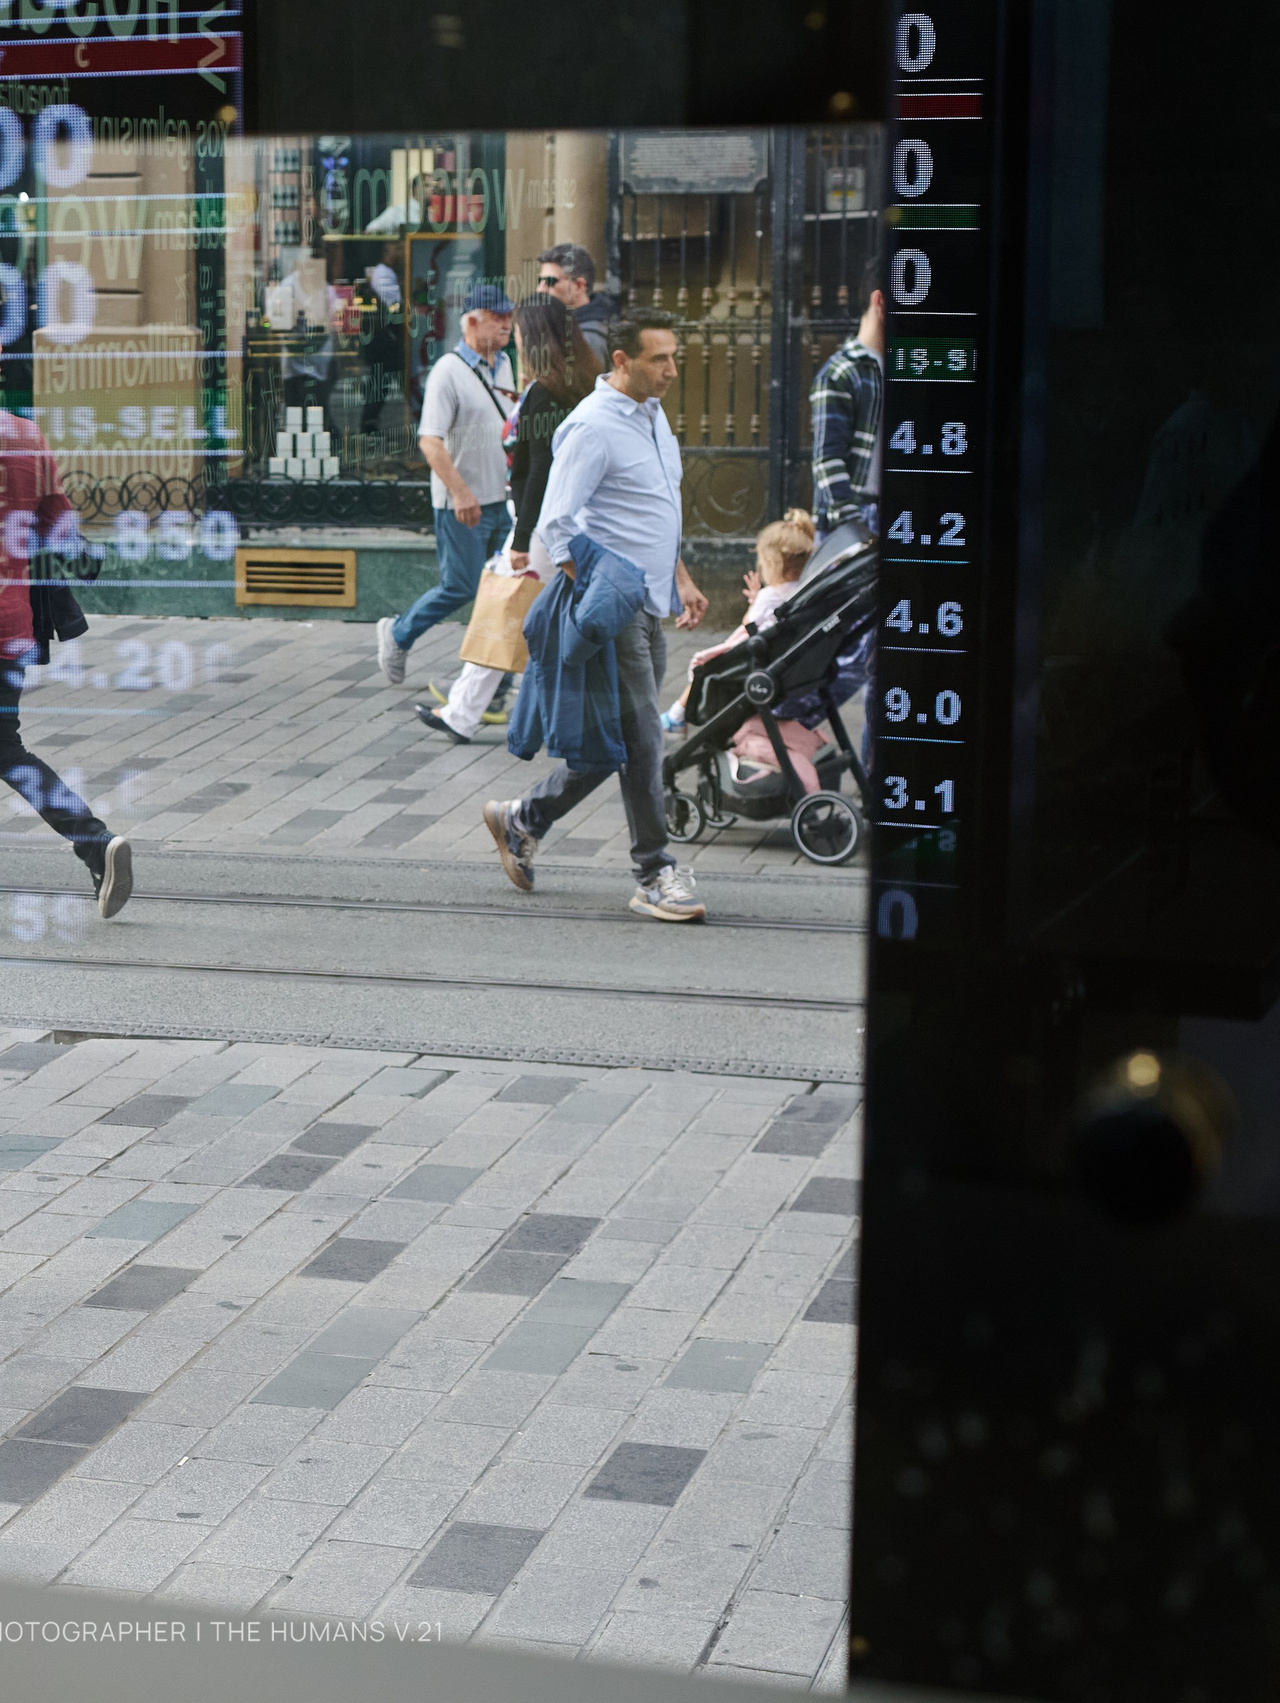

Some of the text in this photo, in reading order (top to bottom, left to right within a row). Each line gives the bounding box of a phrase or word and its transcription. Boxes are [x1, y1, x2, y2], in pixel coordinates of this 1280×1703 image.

[894, 13, 936, 73] 0
[891, 139, 933, 198] 0
[890, 248, 932, 306] 0
[888, 420, 969, 456] 4.8
[3, 510, 239, 560] 64.850
[886, 510, 967, 547] 4.2
[884, 599, 964, 637] 4.6
[883, 686, 962, 726] 9.0
[882, 775, 955, 814] 3.1
